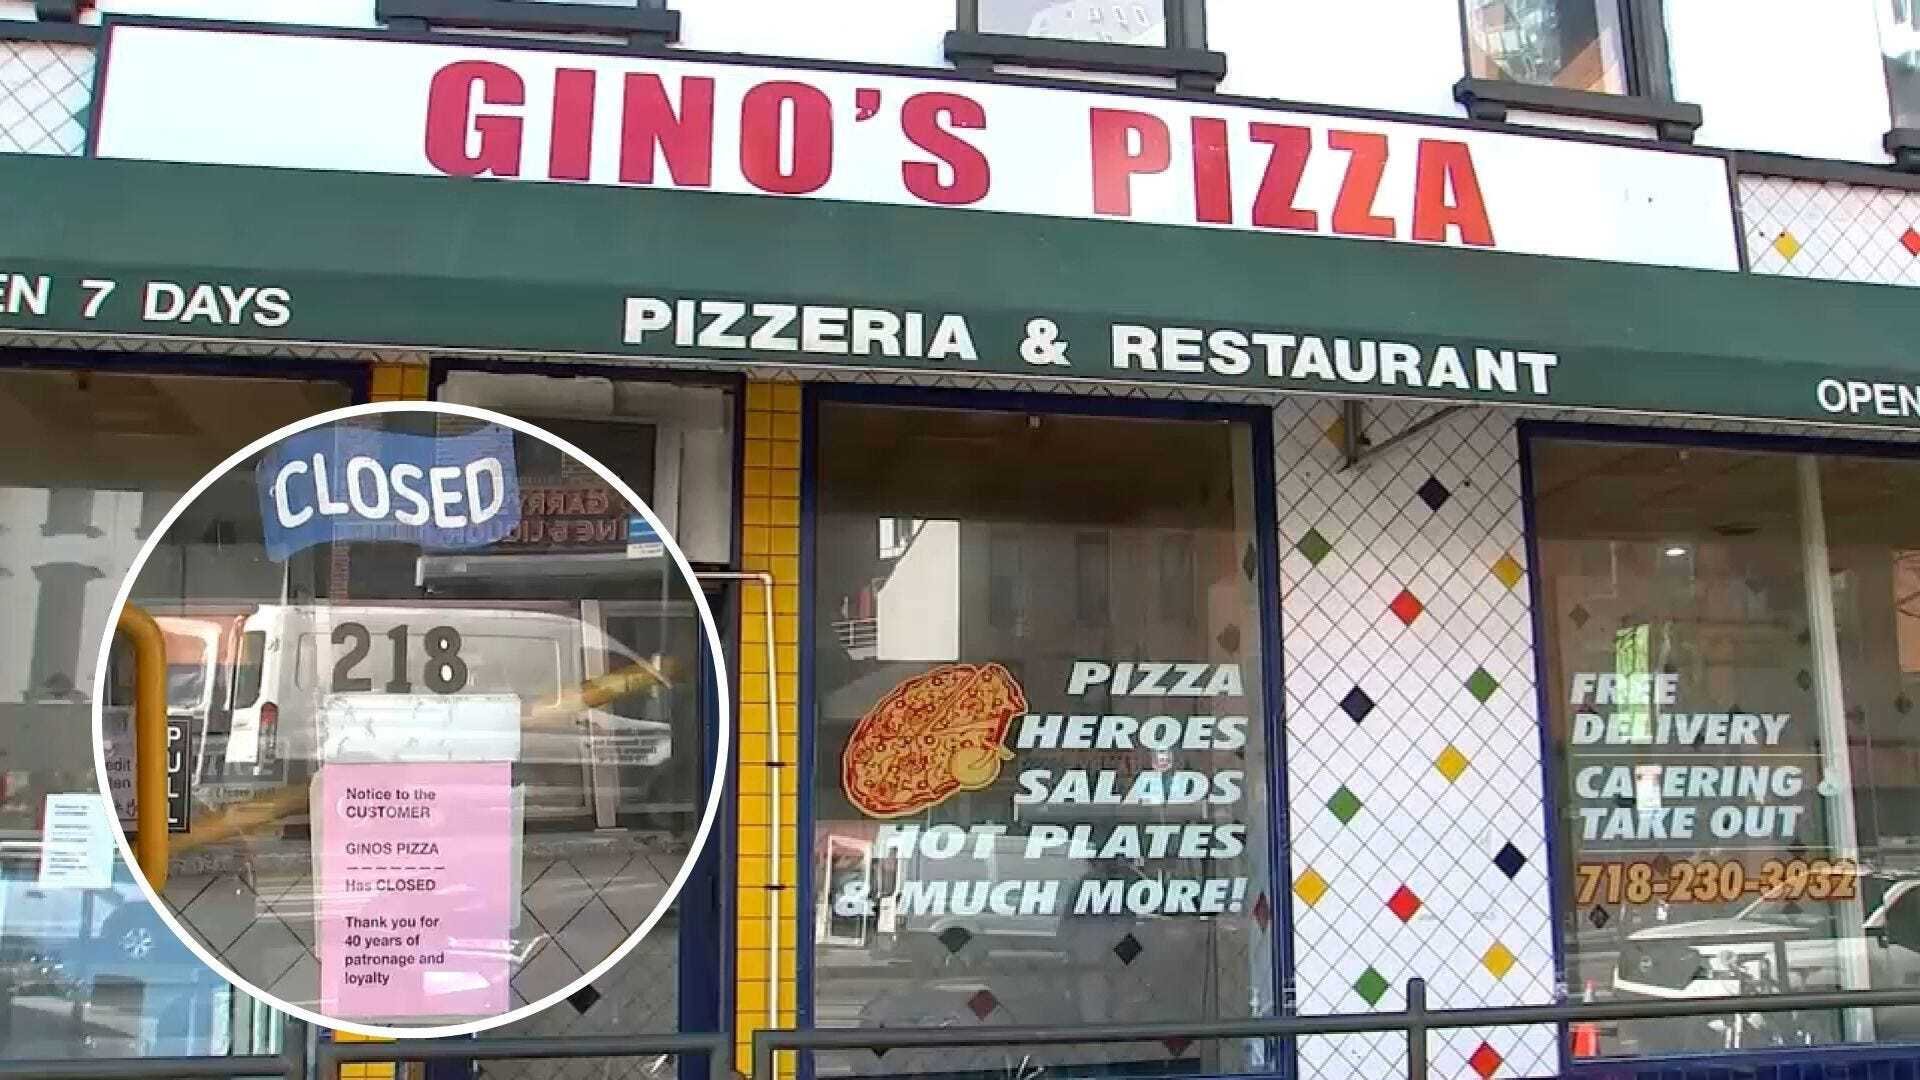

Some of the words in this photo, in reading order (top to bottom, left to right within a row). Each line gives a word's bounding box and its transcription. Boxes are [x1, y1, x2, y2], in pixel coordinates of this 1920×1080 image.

[425, 60, 990, 205] GINO'S
[1089, 106, 1495, 247] PIZZA
[81, 279, 116, 317] 7
[142, 280, 291, 327] DAYS
[623, 297, 979, 361] PIZZERIA
[1019, 317, 1071, 365] &
[1111, 323, 1557, 395] RESTAURANT
[1817, 379, 1920, 416] OPEN
[274, 453, 504, 528] CLOSED
[331, 622, 468, 694] 218
[1068, 661, 1245, 696] PIZZA
[1570, 673, 1680, 704] FREE
[1017, 714, 1248, 749] HEROES
[1571, 713, 1791, 744] DELIVERY
[167, 726, 181, 824] PULL
[1014, 769, 1244, 804] SALADS
[1575, 766, 1802, 798] CATERING
[346, 788, 391, 800] Notice
[396, 789, 409, 800] to
[414, 788, 436, 800] the
[346, 806, 430, 818] CUSTOMER
[1579, 806, 1696, 840] TAKE
[1710, 805, 1805, 838] OUT
[346, 842, 392, 855] GINOS
[397, 843, 439, 855] PIZZA
[872, 824, 1007, 859] HOT
[1024, 823, 1248, 859] PLATES
[345, 879, 372, 892] Has
[376, 879, 436, 892] CLOSED
[833, 881, 876, 916] &
[899, 880, 1059, 915] MUCH
[1073, 877, 1248, 915] MORE!
[1576, 857, 1858, 905] 718-230-3932
[344, 916, 387, 928] Thank
[391, 918, 416, 930] you
[420, 915, 440, 927] for
[344, 935, 361, 947] 40
[365, 936, 402, 948] years
[406, 934, 420, 946] of
[345, 954, 415, 967] patronage
[419, 952, 445, 964] and
[345, 972, 389, 986] loyalty
